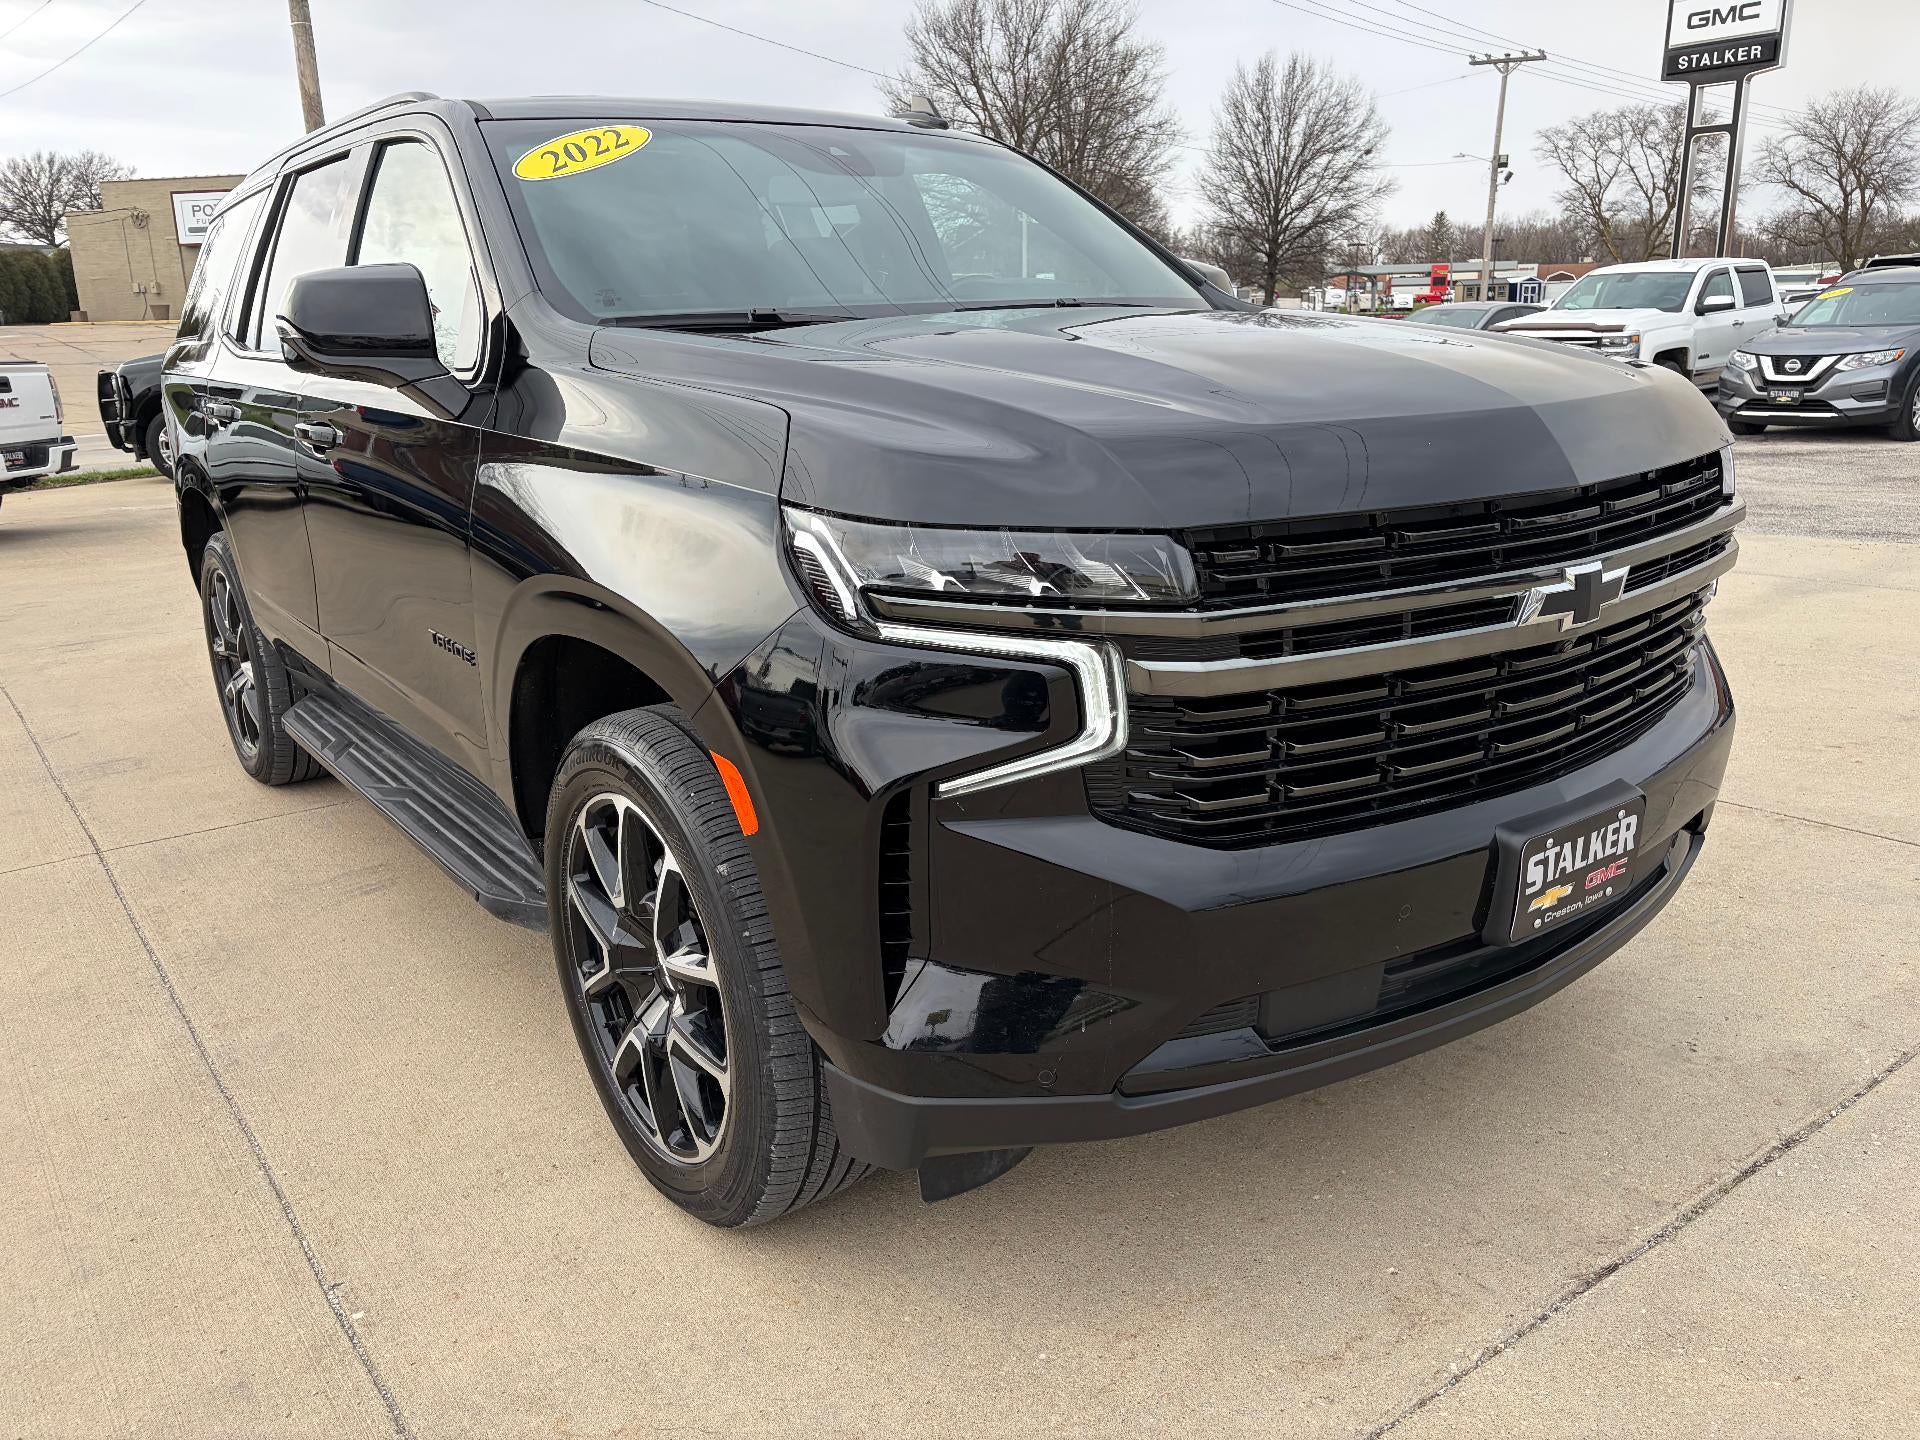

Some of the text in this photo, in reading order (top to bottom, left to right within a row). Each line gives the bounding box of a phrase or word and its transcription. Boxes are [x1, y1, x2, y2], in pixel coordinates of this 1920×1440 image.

[1687, 1, 1761, 29] GMC
[1678, 46, 1761, 69] STALKER
[541, 130, 629, 173] 2022
[1770, 390, 1799, 398] STALKER
[4, 452, 24, 460] TALKER
[428, 628, 476, 667] TAHOE
[1525, 814, 1638, 895] STALKER
[1585, 857, 1628, 890] GMC
[1544, 890, 1604, 922] Creston, Iowa
